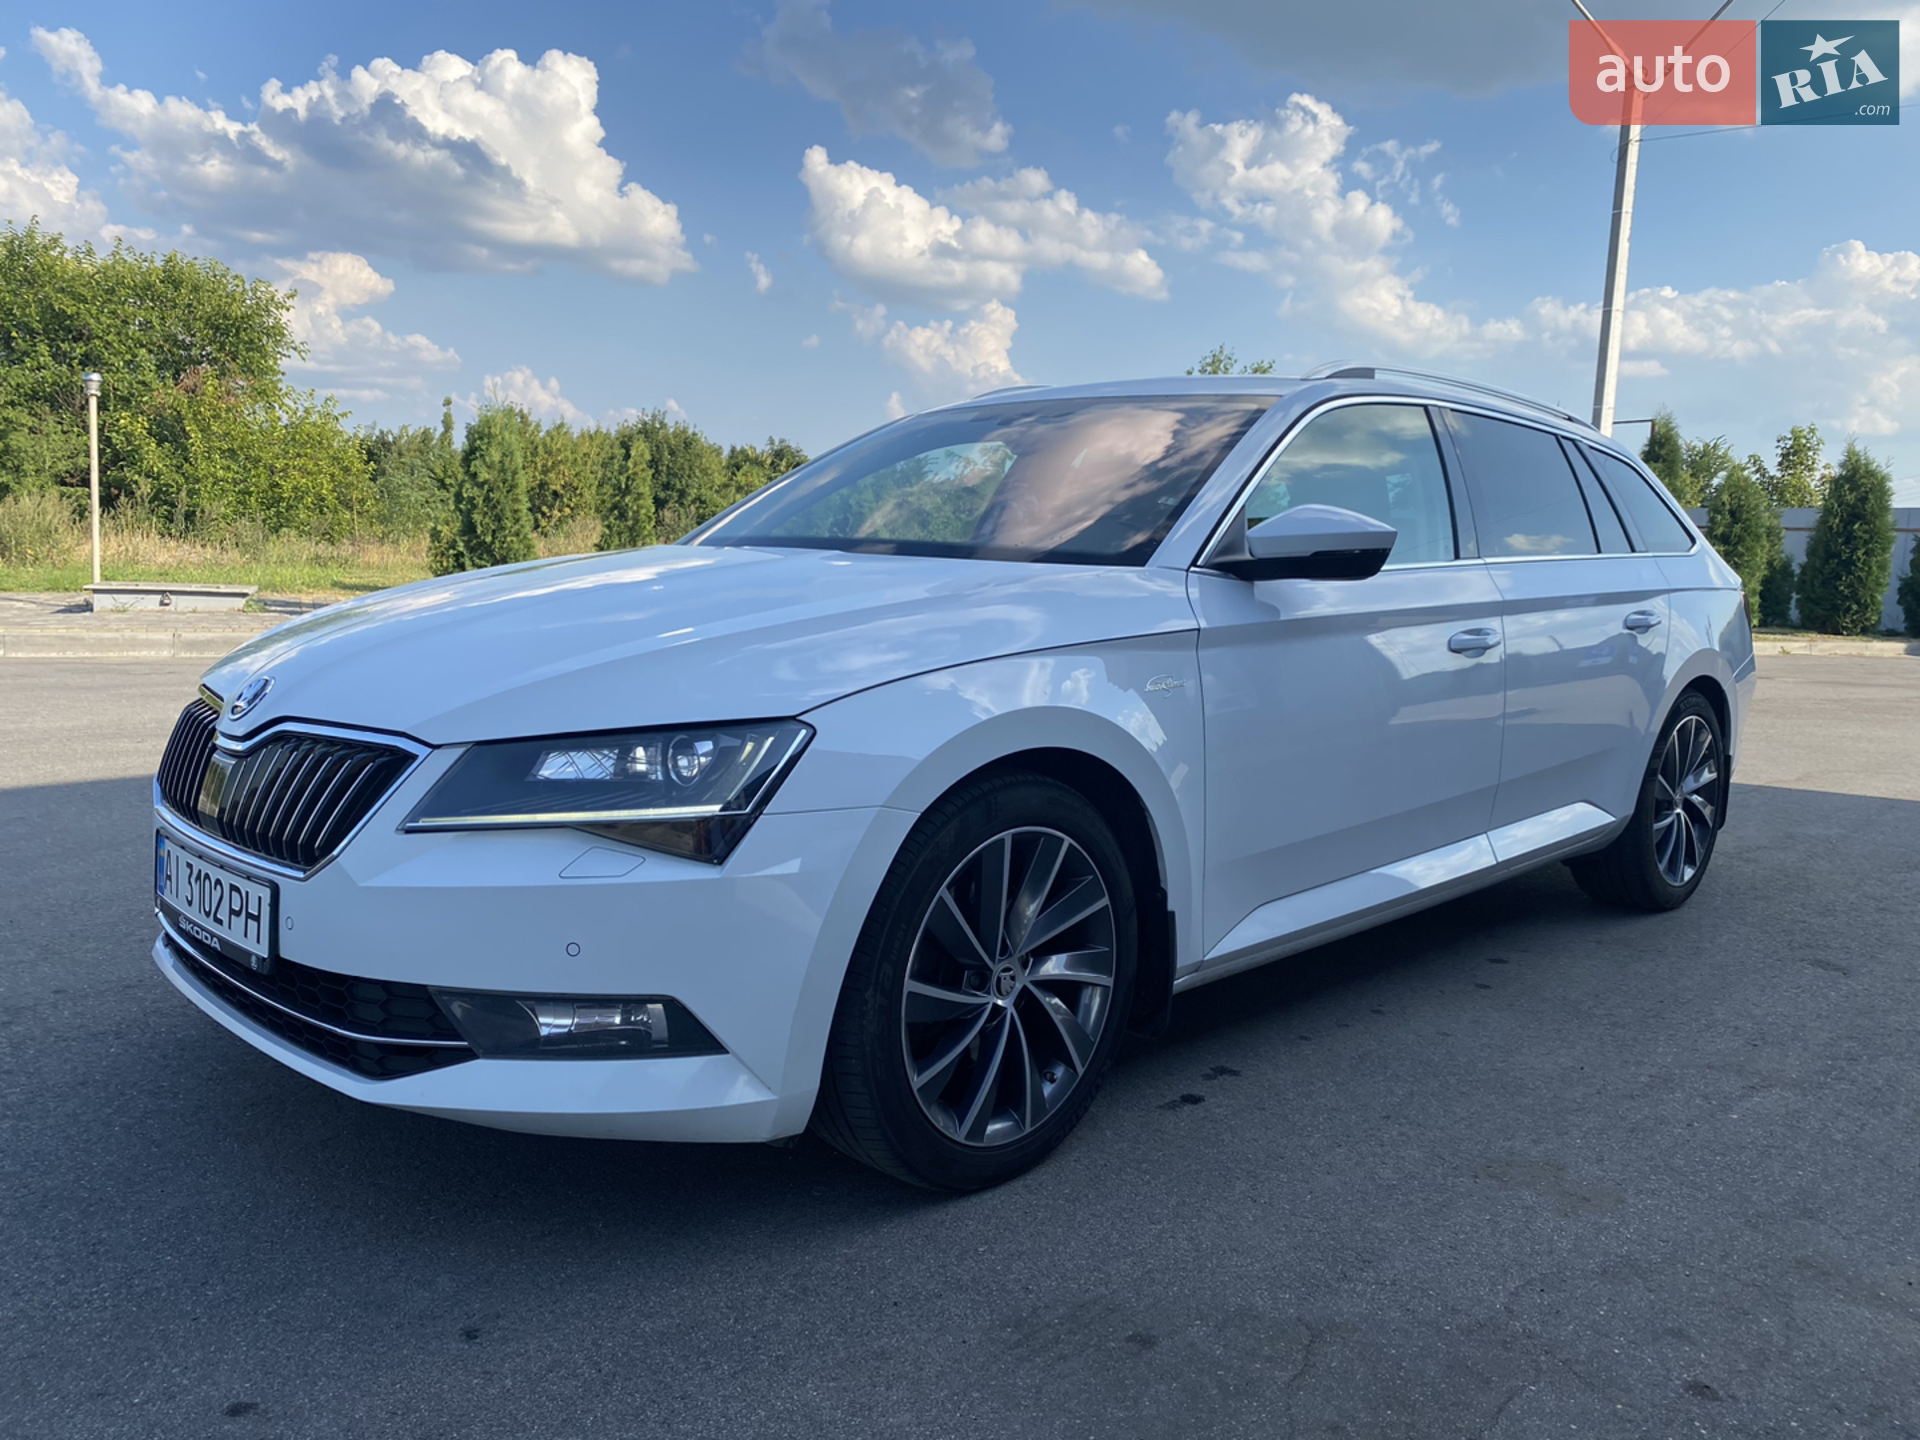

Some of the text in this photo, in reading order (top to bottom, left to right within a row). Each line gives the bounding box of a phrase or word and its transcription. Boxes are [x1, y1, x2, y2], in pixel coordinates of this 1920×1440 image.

[164, 849, 262, 945] AI 3102 PH
